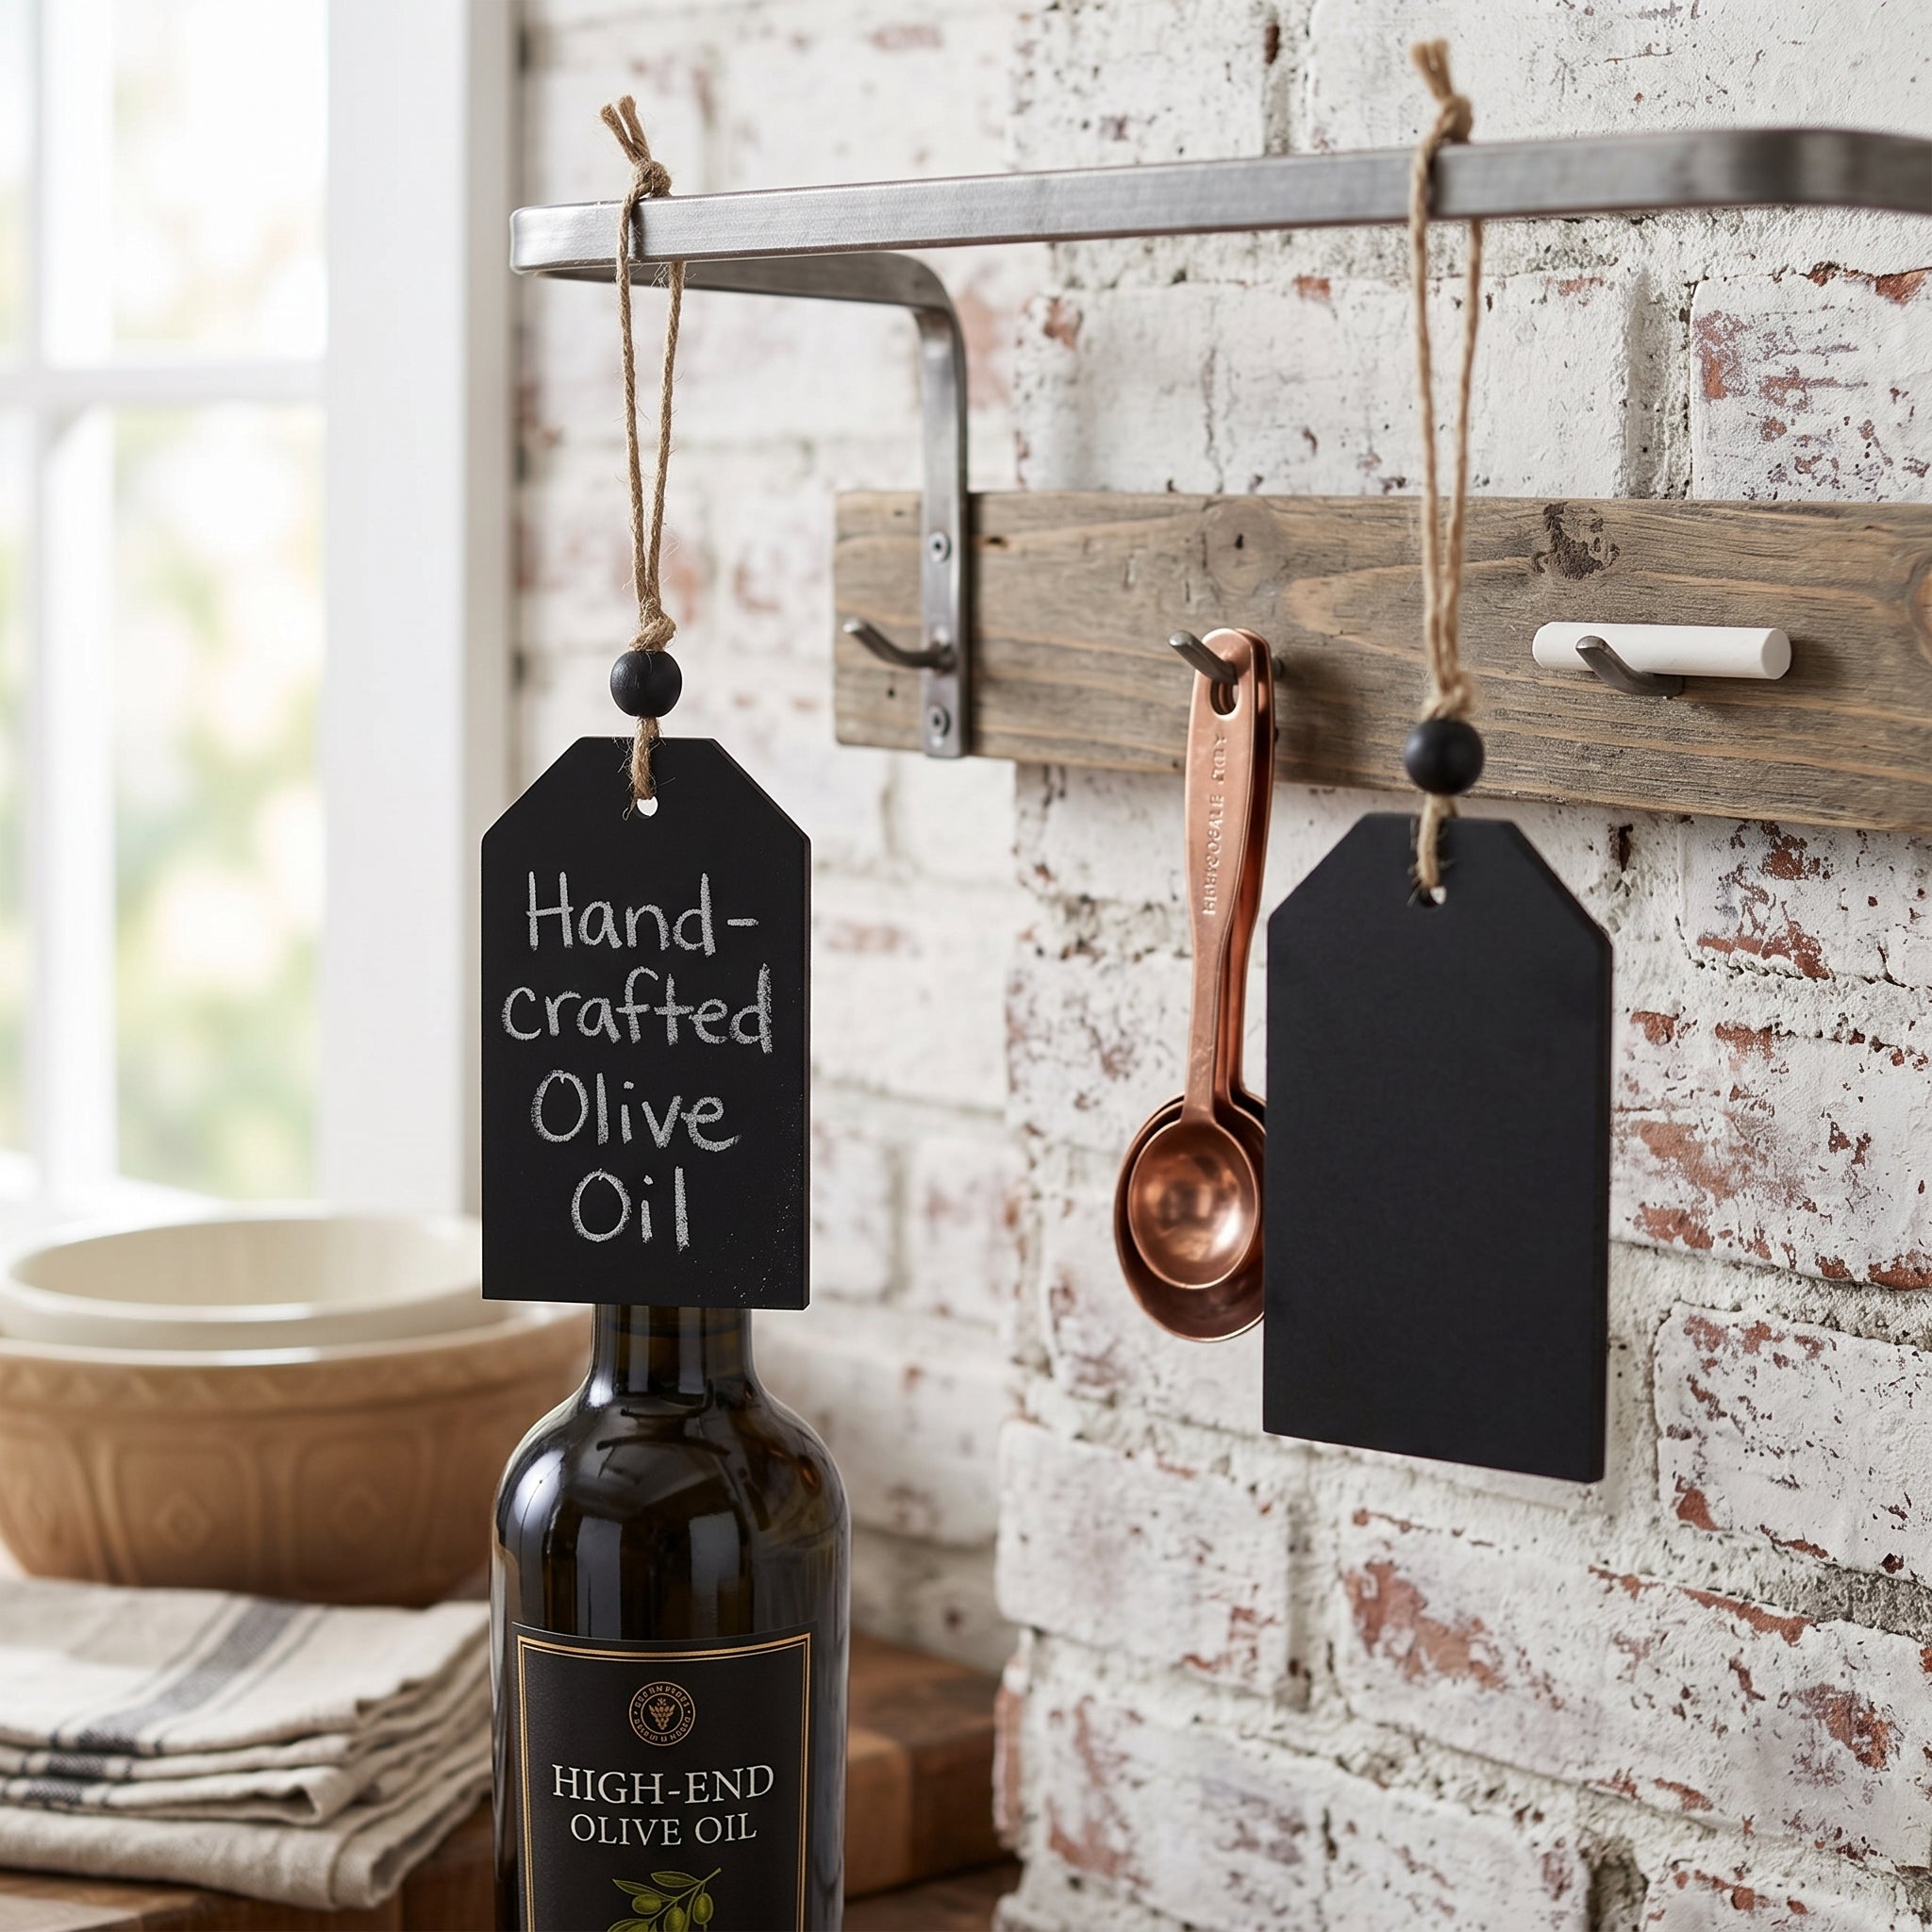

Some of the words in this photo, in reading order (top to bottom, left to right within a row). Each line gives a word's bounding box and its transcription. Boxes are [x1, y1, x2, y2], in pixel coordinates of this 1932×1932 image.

[525, 871, 759, 957] Hand-
[501, 962, 774, 1054] crafted
[530, 1069, 741, 1152] Olive
[571, 1166, 691, 1252] Oil
[551, 1763, 774, 1805] HIGH-END
[570, 1813, 682, 1846] OLIVE
[694, 1812, 758, 1844] OIL
